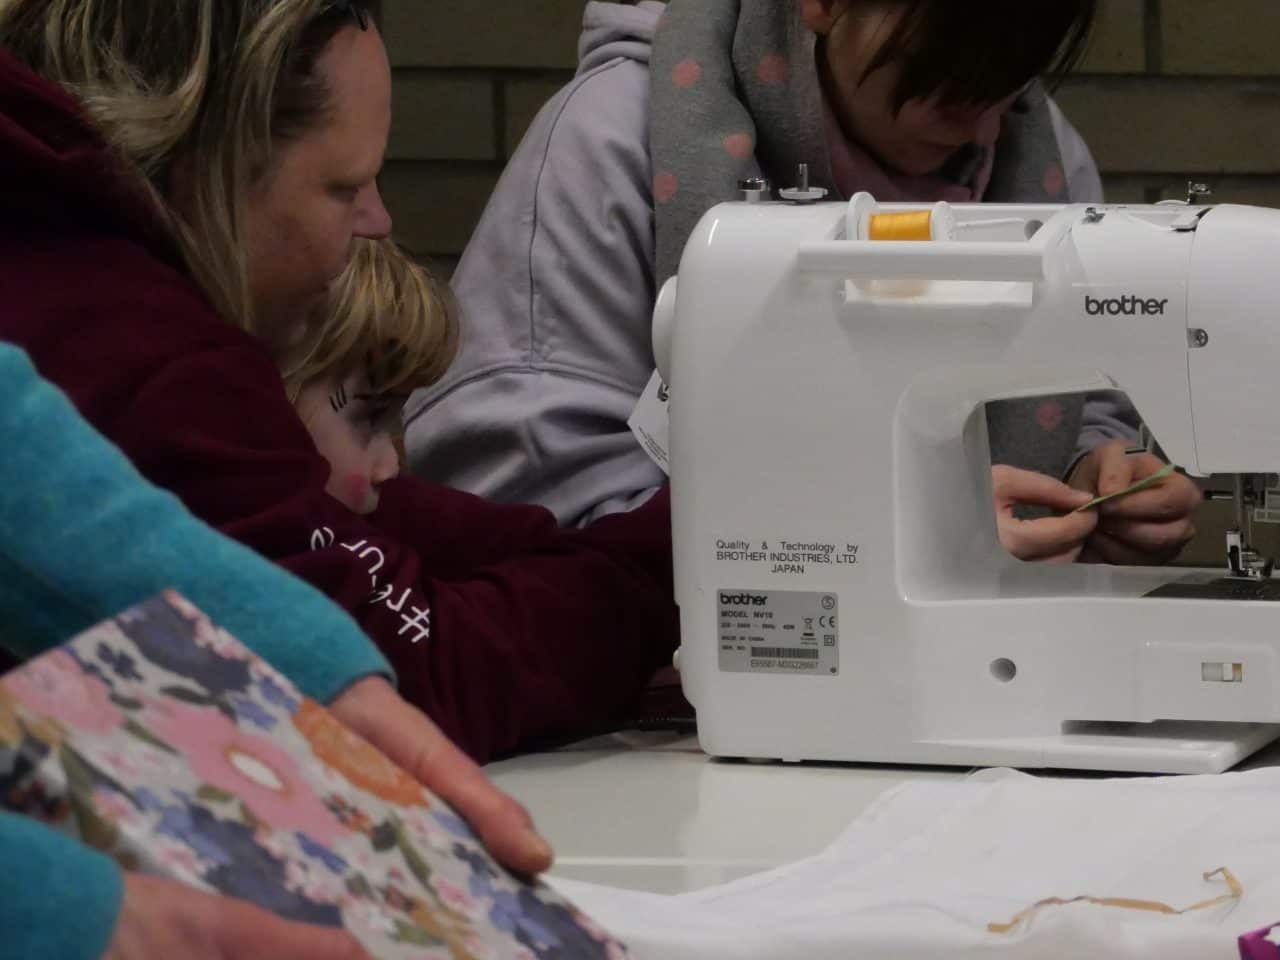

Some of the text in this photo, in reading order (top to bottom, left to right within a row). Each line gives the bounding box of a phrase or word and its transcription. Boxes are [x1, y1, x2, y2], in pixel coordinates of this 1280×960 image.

[1085, 295, 1168, 315] brother
[716, 540, 858, 553] Quality & Technology by
[716, 552, 858, 564] BROTHER INDUSTRIES, LTD.
[771, 565, 804, 574] JAPAN
[720, 593, 767, 606] brother
